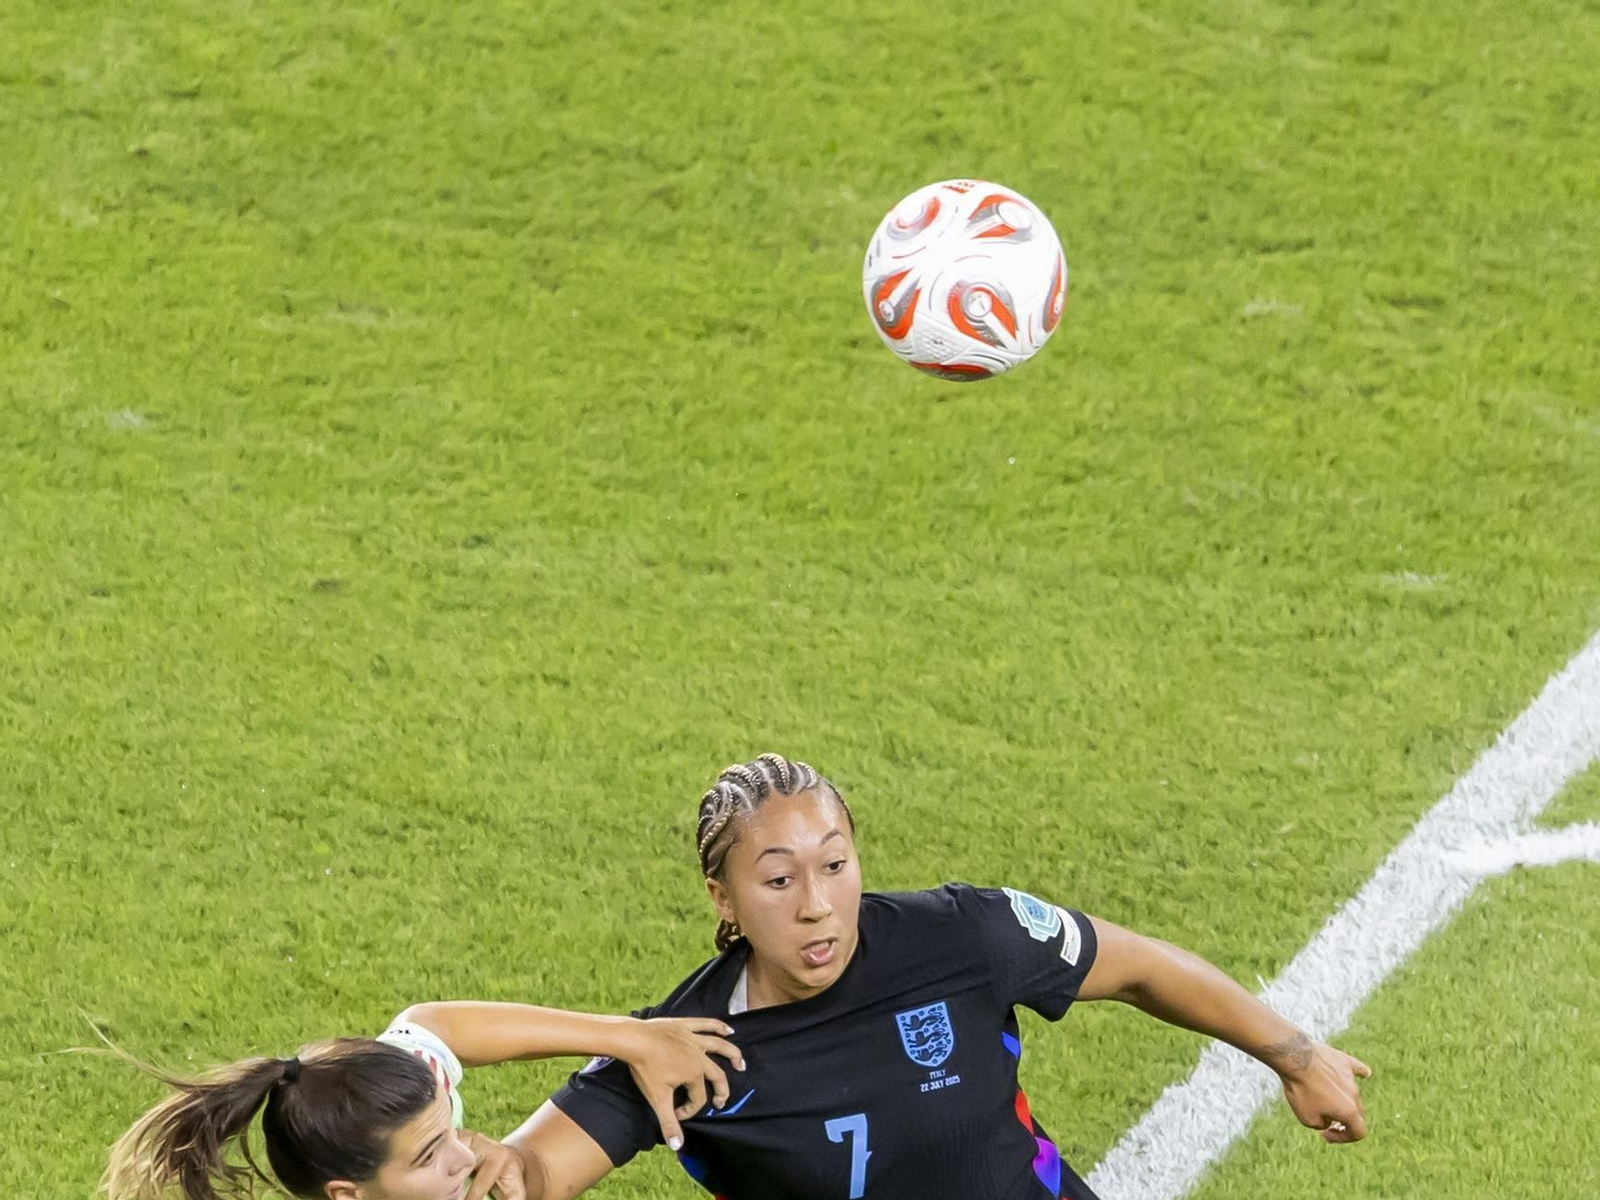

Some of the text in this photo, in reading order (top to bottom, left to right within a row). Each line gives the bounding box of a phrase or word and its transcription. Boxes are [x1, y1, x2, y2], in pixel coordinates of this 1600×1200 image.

[920, 1083, 929, 1092] 22
[930, 1079, 944, 1090] JULY
[824, 1113, 873, 1200] 7
